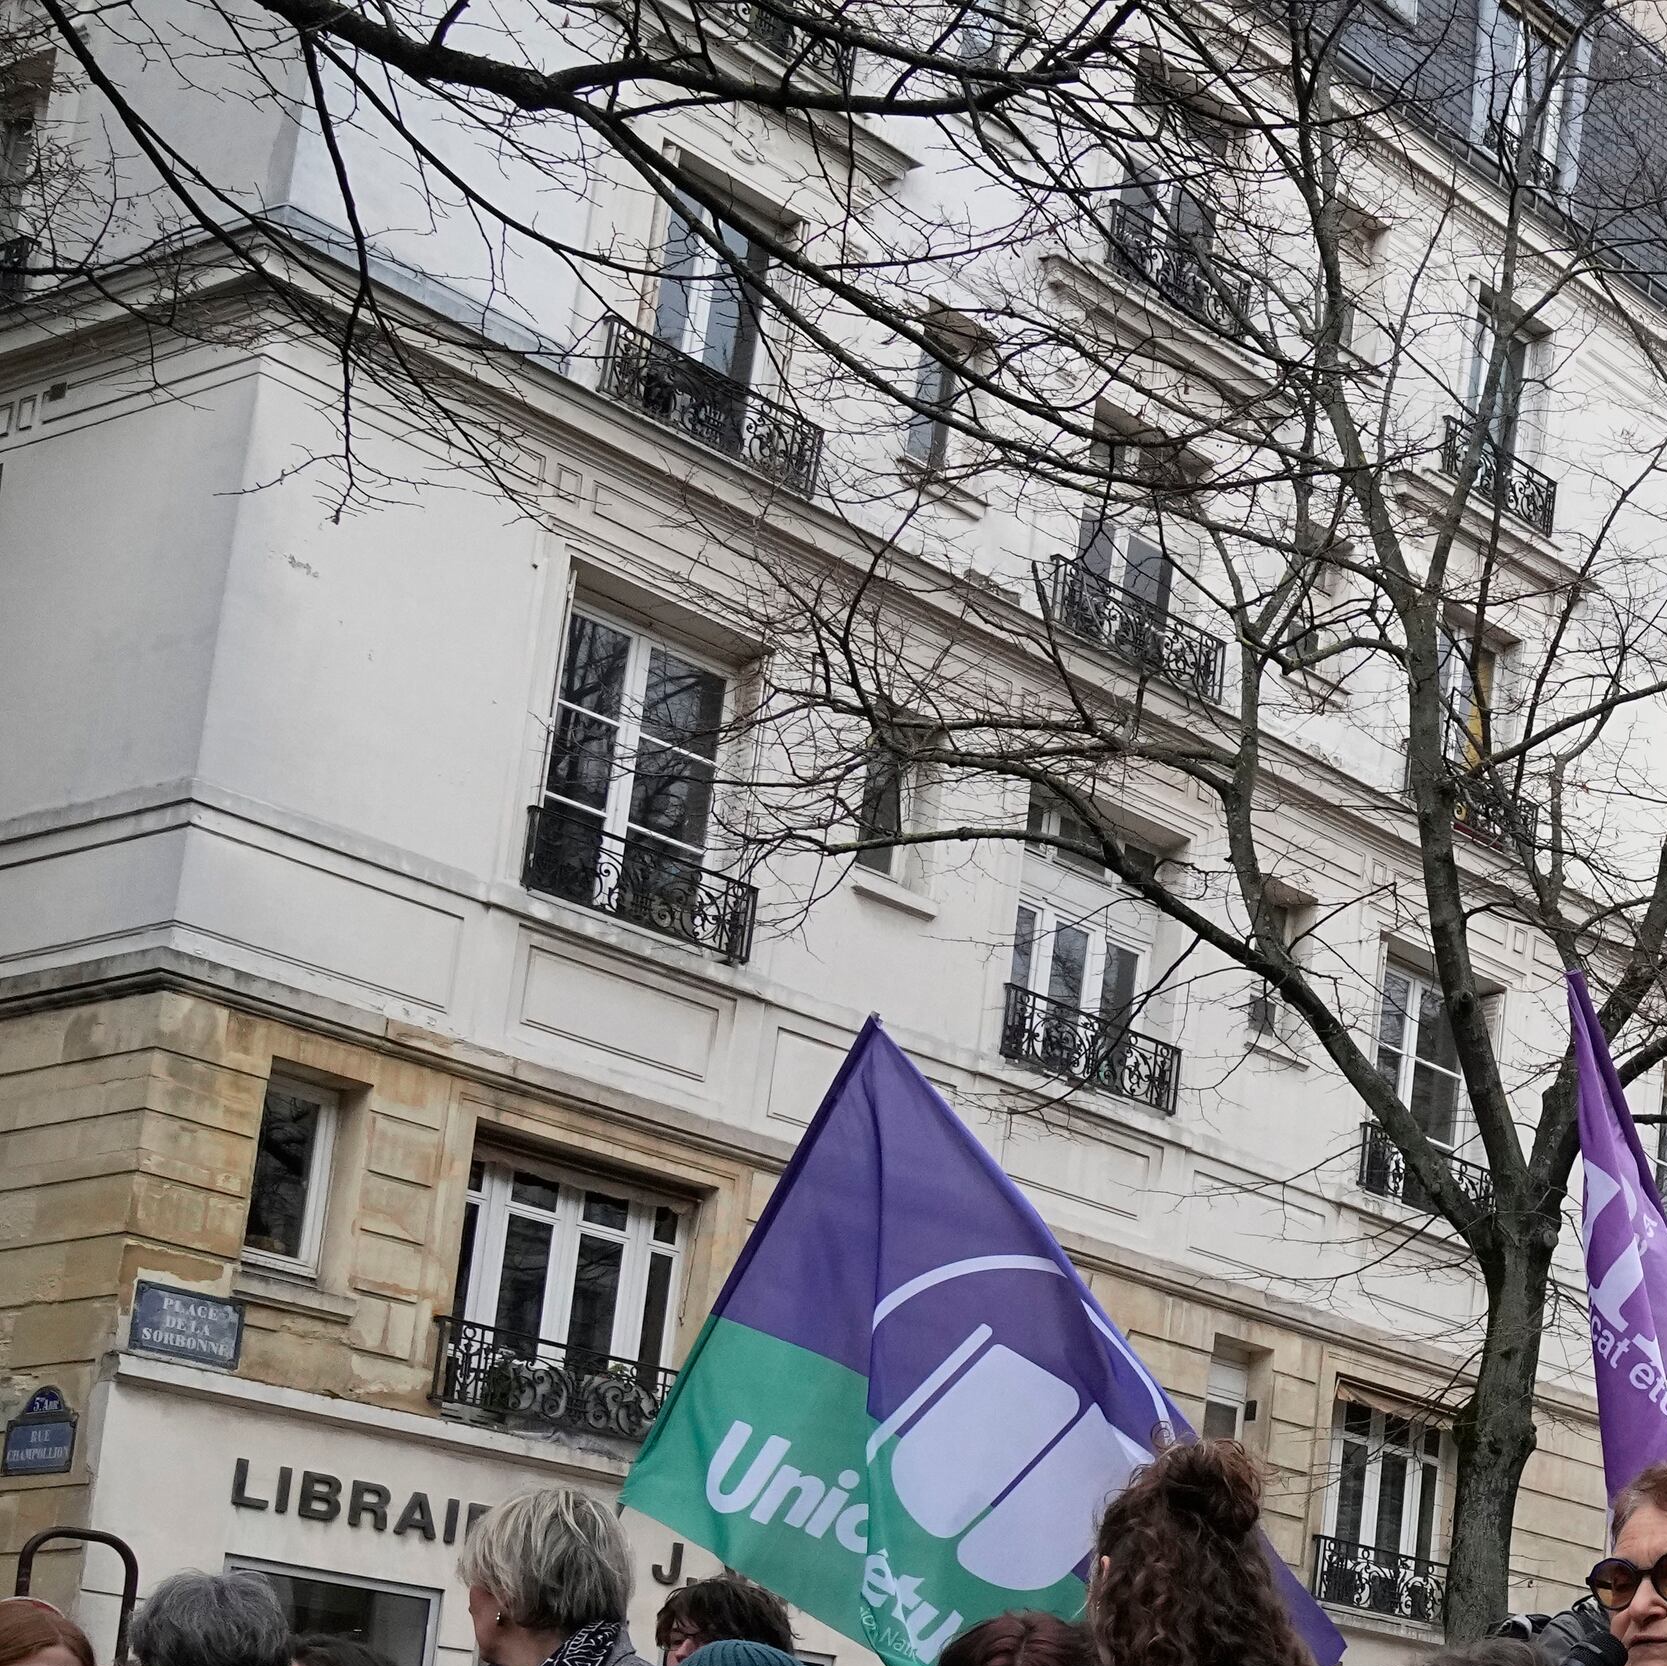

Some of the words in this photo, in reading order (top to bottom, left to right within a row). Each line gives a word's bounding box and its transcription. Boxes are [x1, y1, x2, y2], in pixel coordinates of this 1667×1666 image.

[163, 1297, 218, 1321] PLACE
[166, 1315, 188, 1331] DE
[141, 1327, 233, 1358] SORBONNE
[1590, 1308, 1631, 1369] cat
[30, 1430, 50, 1443] RUE
